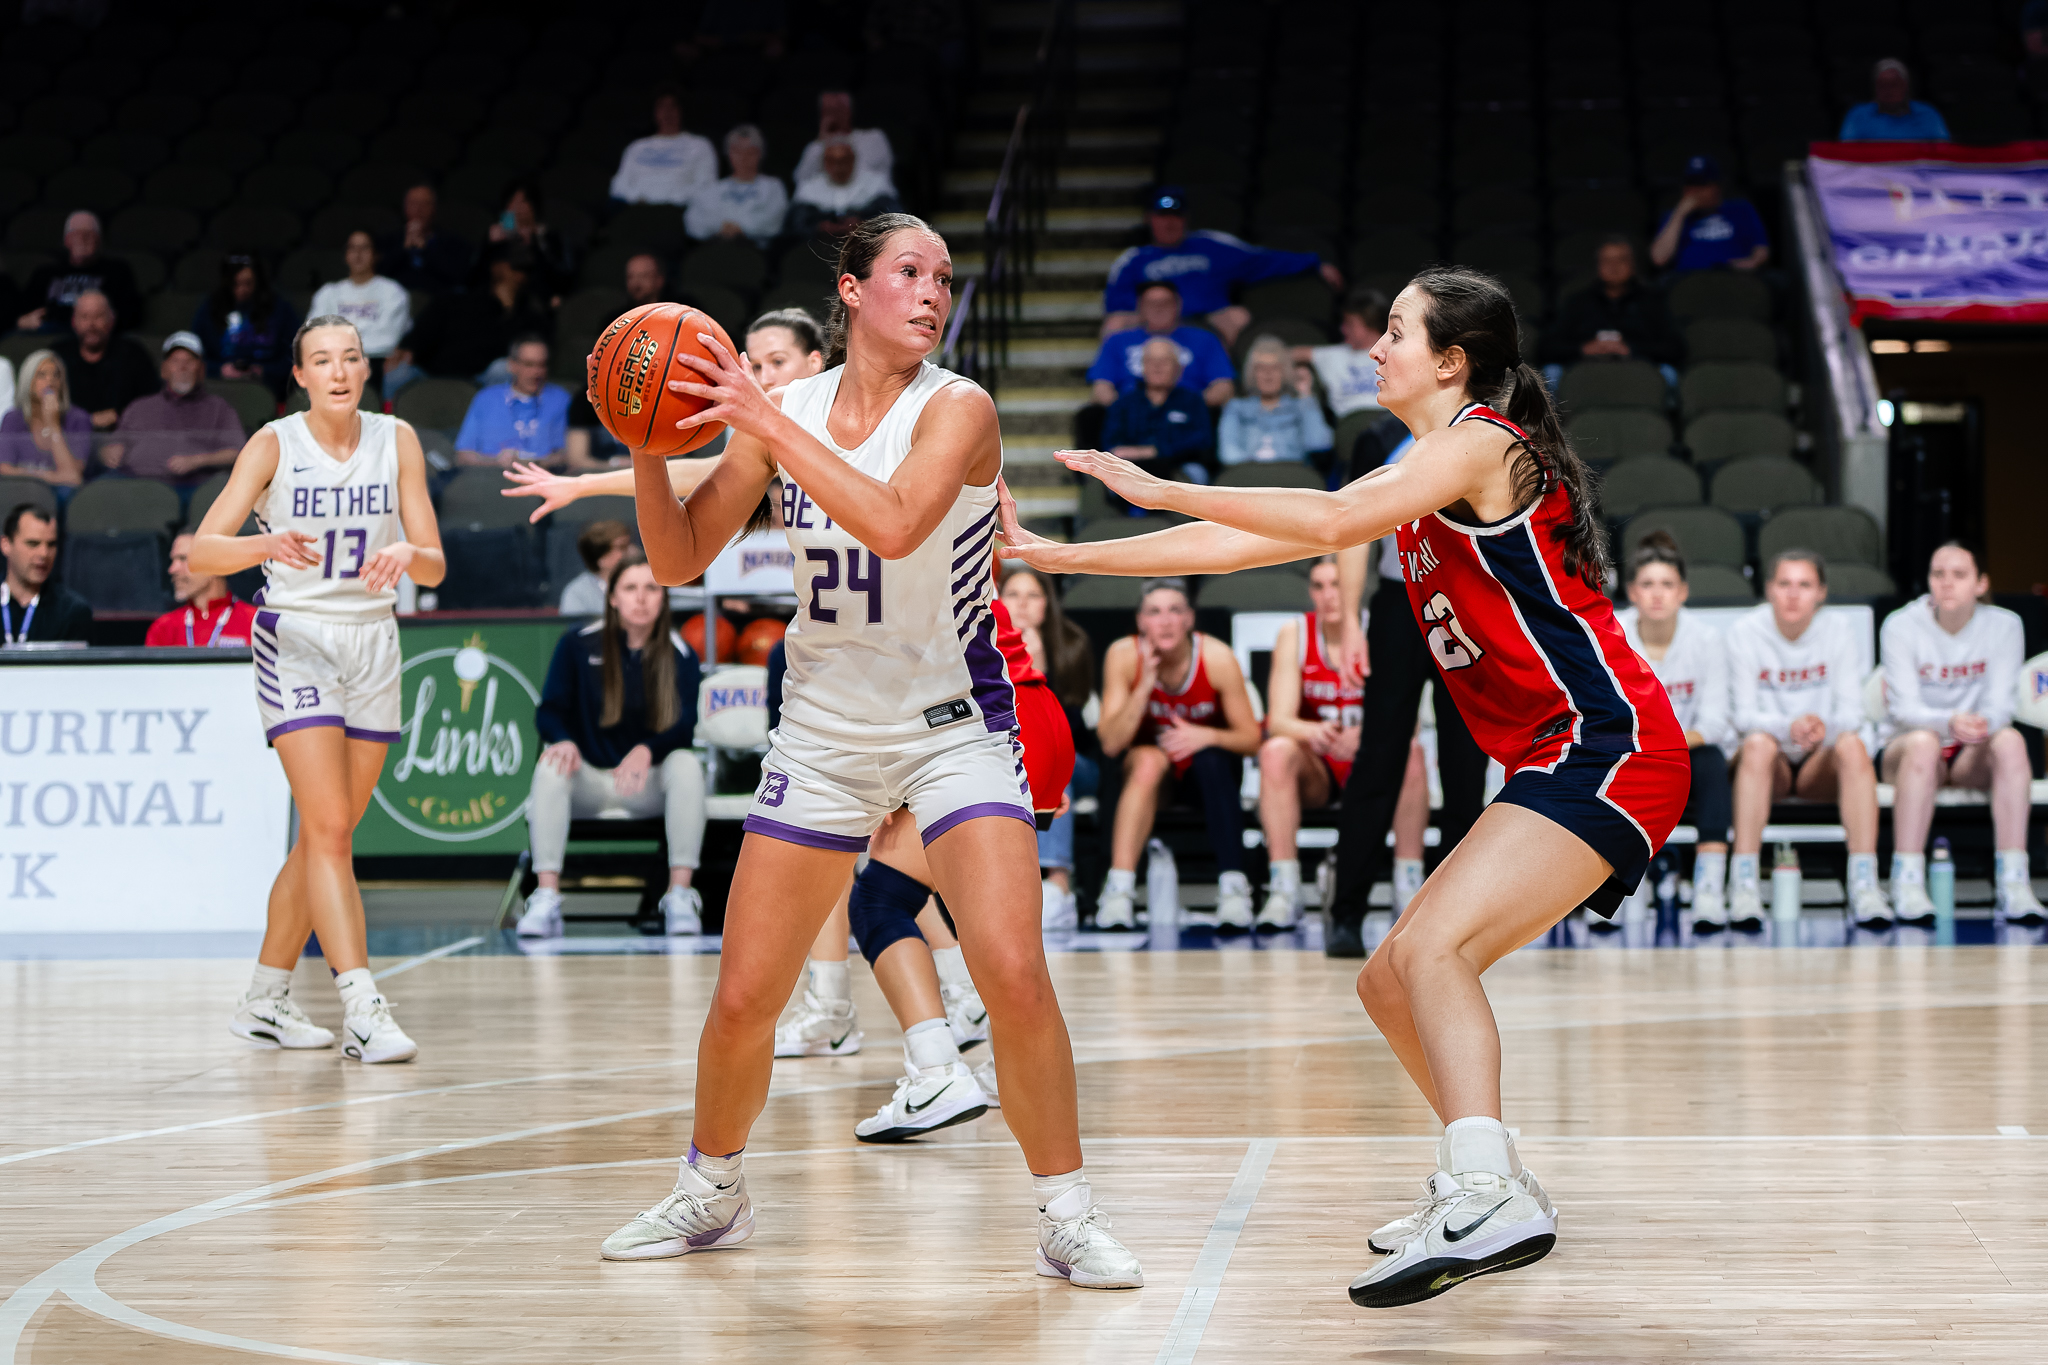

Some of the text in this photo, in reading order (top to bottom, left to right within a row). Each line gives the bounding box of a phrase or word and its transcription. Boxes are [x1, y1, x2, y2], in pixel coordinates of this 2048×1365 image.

[615, 328, 651, 419] LEGACY
[634, 339, 659, 396] 1000
[292, 484, 393, 518] BETHEL
[322, 528, 367, 579] 13
[803, 546, 884, 626] 24
[393, 675, 523, 784] Links
[955, 704, 965, 713] M
[0, 780, 223, 828] IONAL
